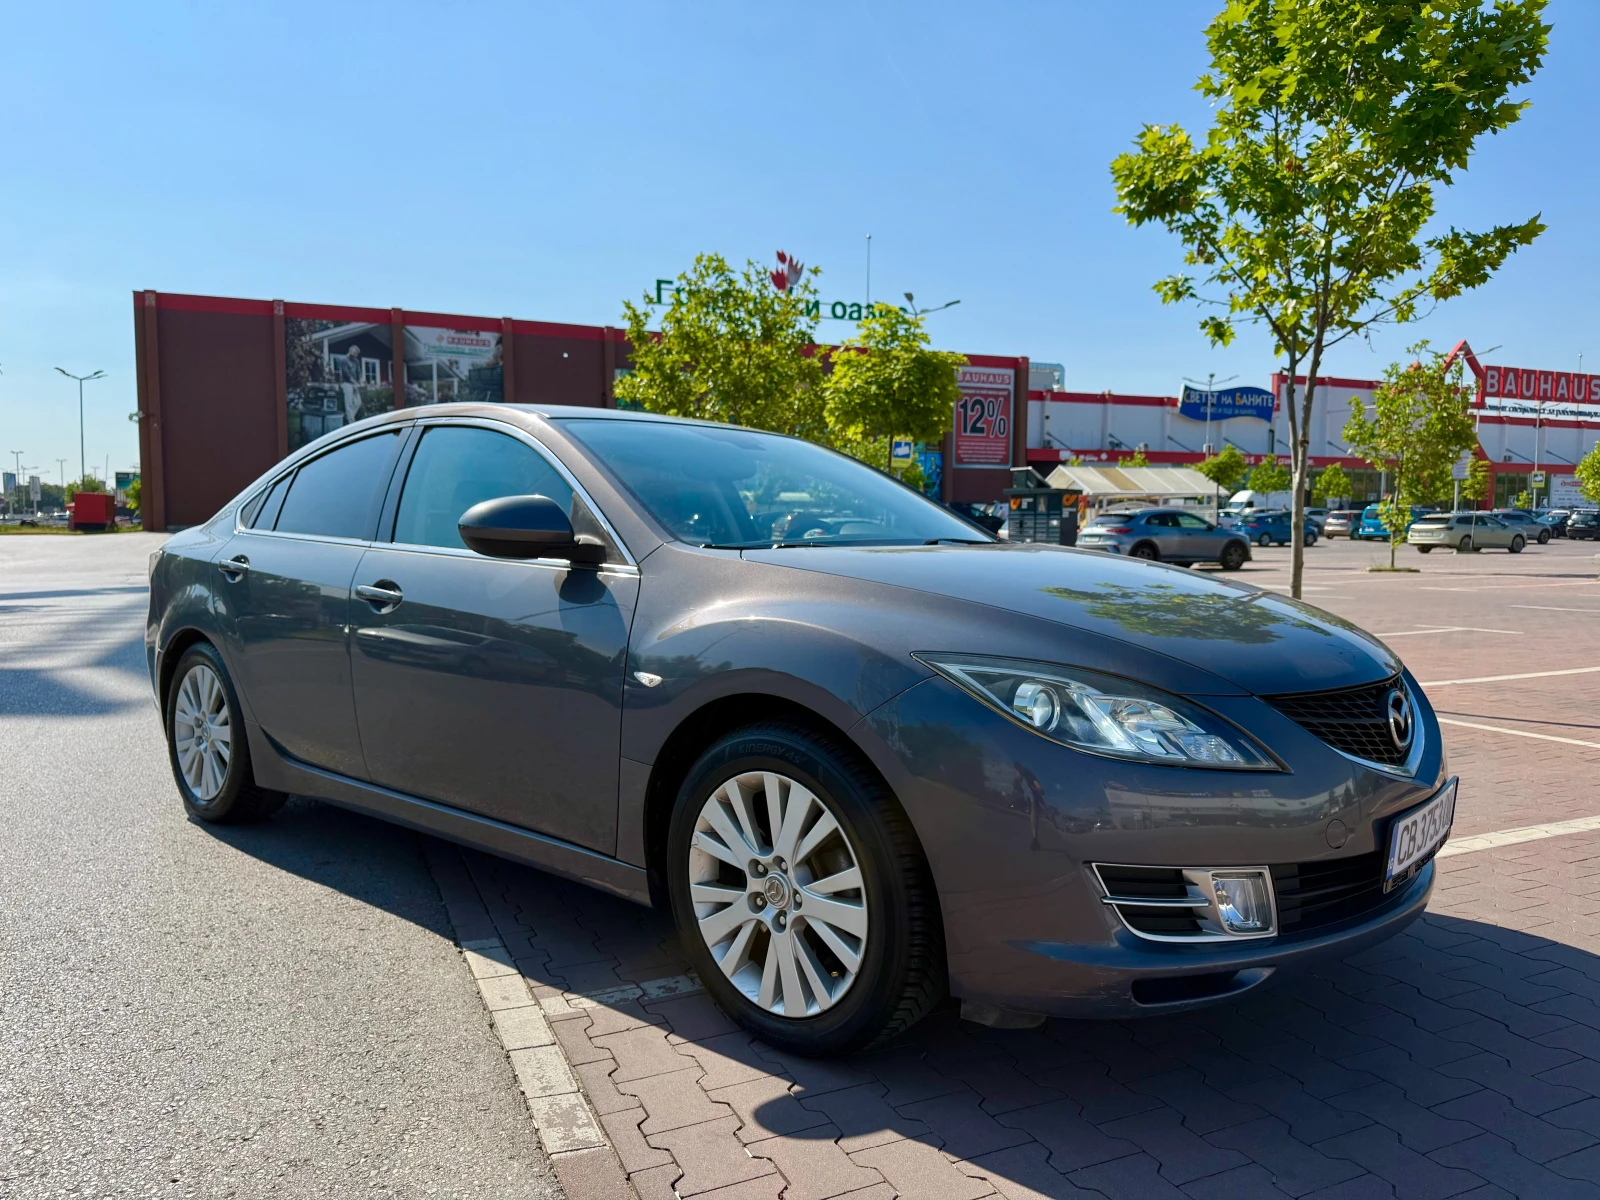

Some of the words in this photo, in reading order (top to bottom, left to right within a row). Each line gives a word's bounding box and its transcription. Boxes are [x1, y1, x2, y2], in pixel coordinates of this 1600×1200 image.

[957, 372, 1010, 384] BAUHAUS
[1486, 370, 1600, 401] BAUHAUS
[1235, 392, 1273, 408] БАНИТЕ
[958, 397, 1007, 438] 12%
